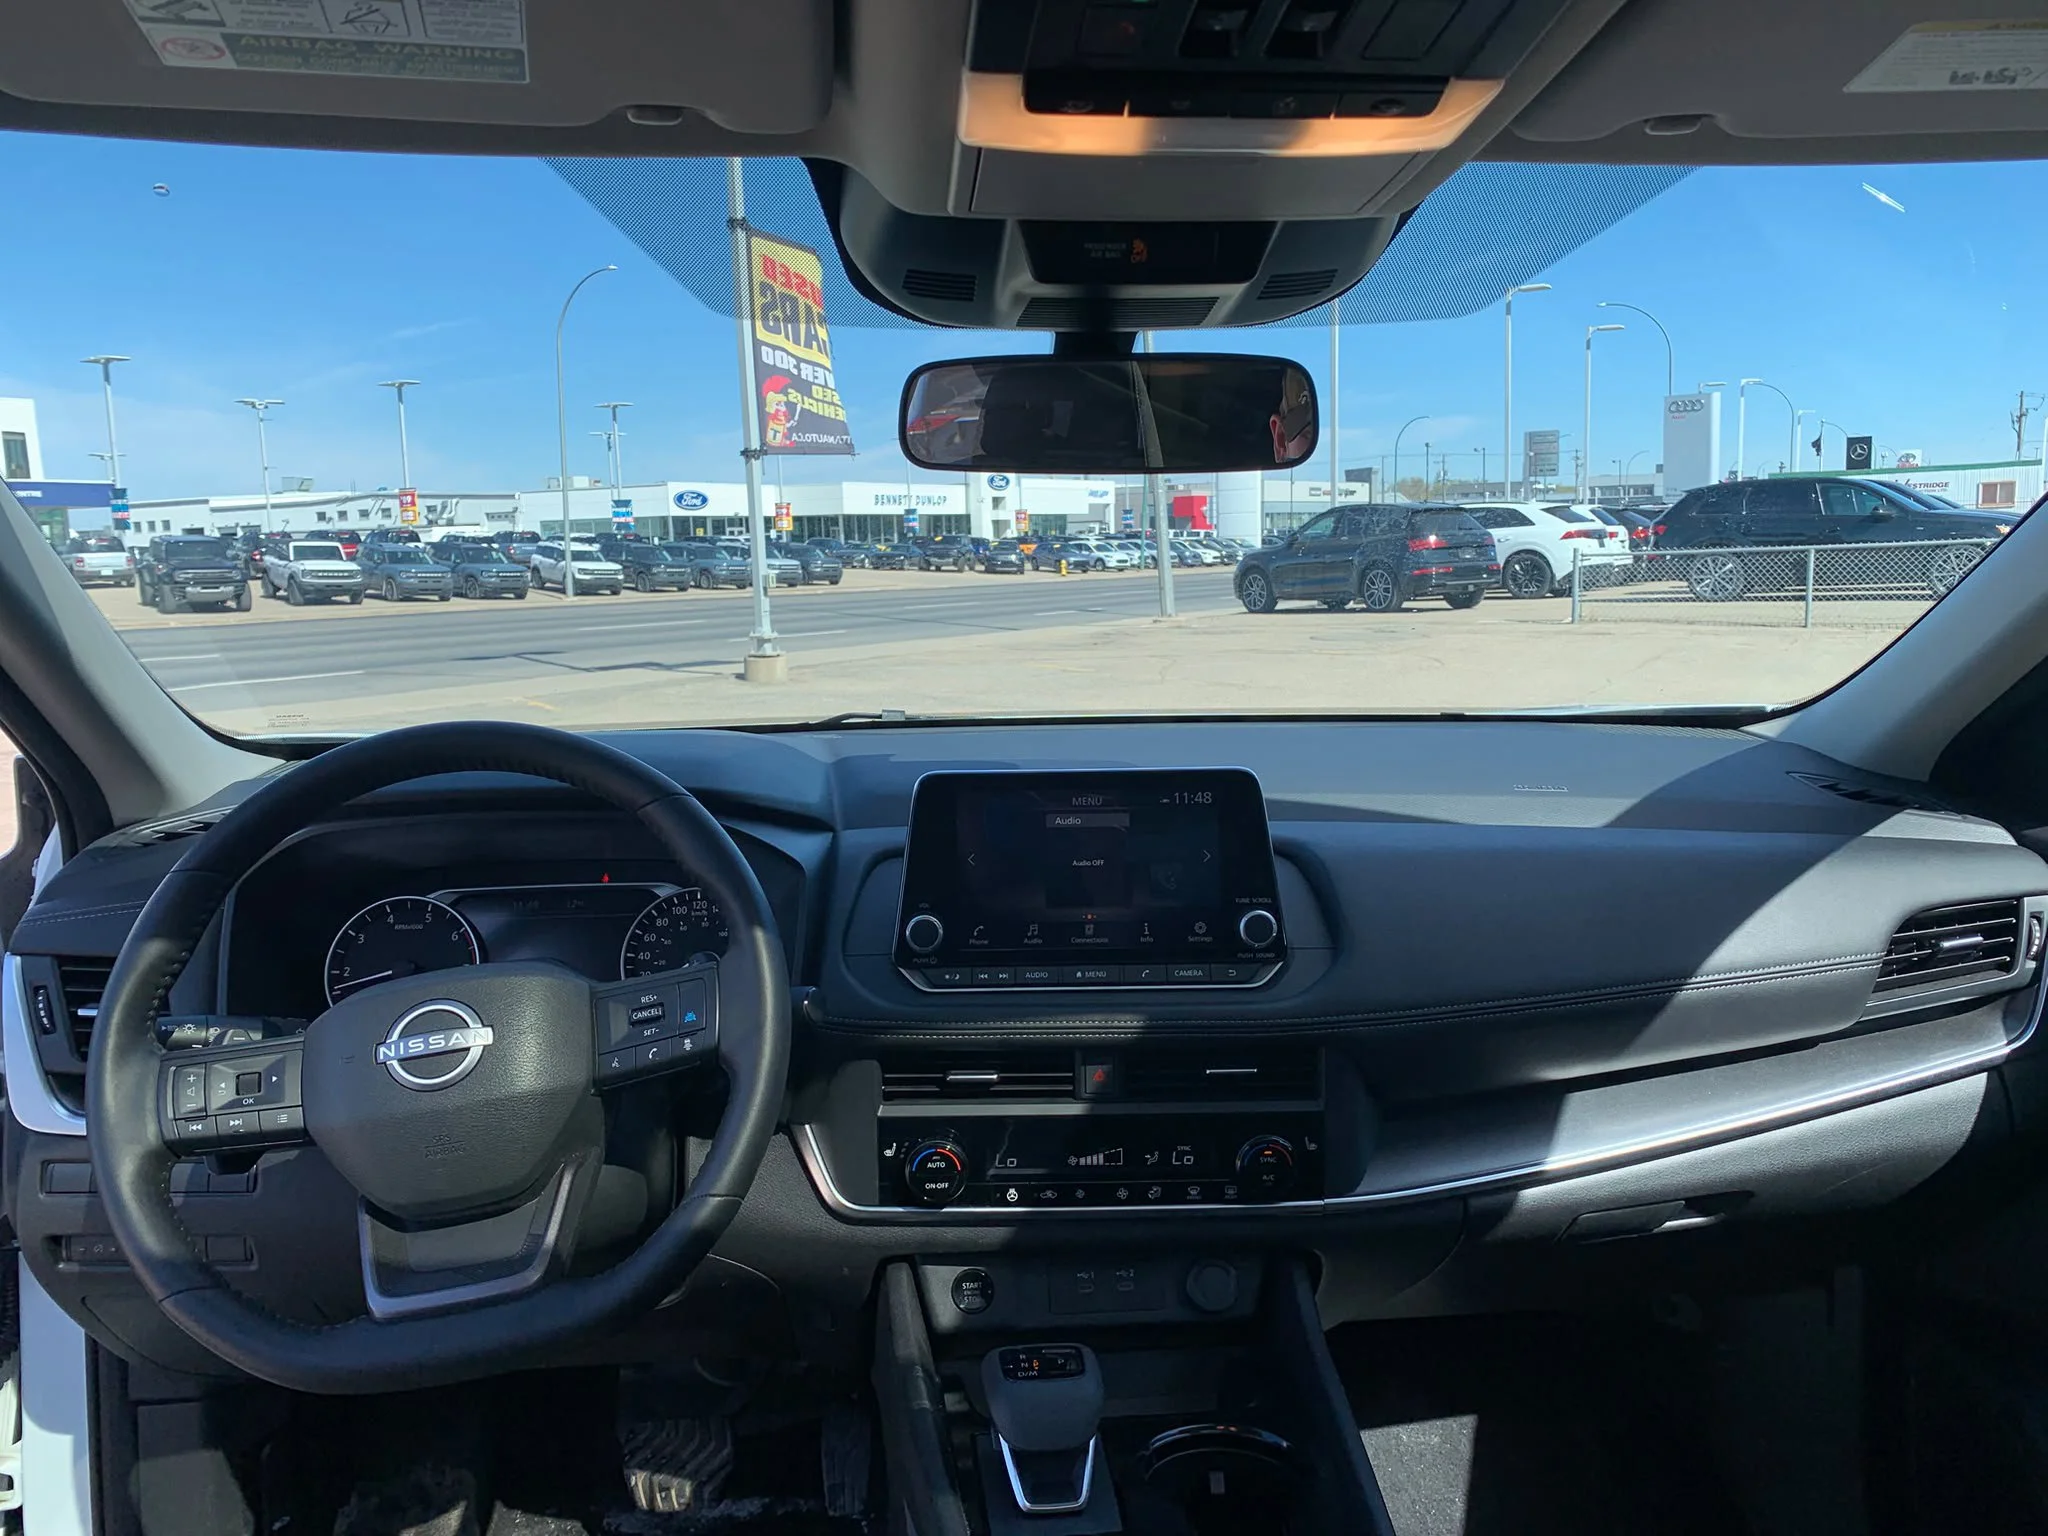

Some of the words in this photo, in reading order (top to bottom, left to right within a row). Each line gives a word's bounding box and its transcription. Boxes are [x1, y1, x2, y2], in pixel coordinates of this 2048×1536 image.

[240, 36, 357, 51] AIRBAG
[374, 44, 516, 60] WARNING
[916, 494, 948, 506] DUNLOP
[1072, 797, 1103, 806] MENU
[1174, 791, 1213, 804] 11:48
[1055, 816, 1082, 825] Audio
[693, 900, 708, 909] 120
[672, 906, 688, 915] 100
[387, 914, 394, 924] 4
[425, 913, 432, 923] 5
[656, 918, 669, 927] 80
[357, 933, 365, 944] 3
[451, 931, 459, 941] 6
[644, 933, 656, 942] 60
[638, 951, 651, 960] 40
[343, 966, 351, 977] 2
[1025, 971, 1049, 979] AUDIO
[1085, 970, 1107, 978] MENU
[1174, 969, 1204, 977] CAMERA
[641, 994, 657, 1003] RES+
[632, 1008, 662, 1020] CANCEL
[379, 1029, 489, 1060] NISSAN
[242, 1097, 255, 1105] OK
[926, 1161, 946, 1169] AUTO
[962, 1281, 983, 1290] START
[963, 1296, 978, 1304] STO
